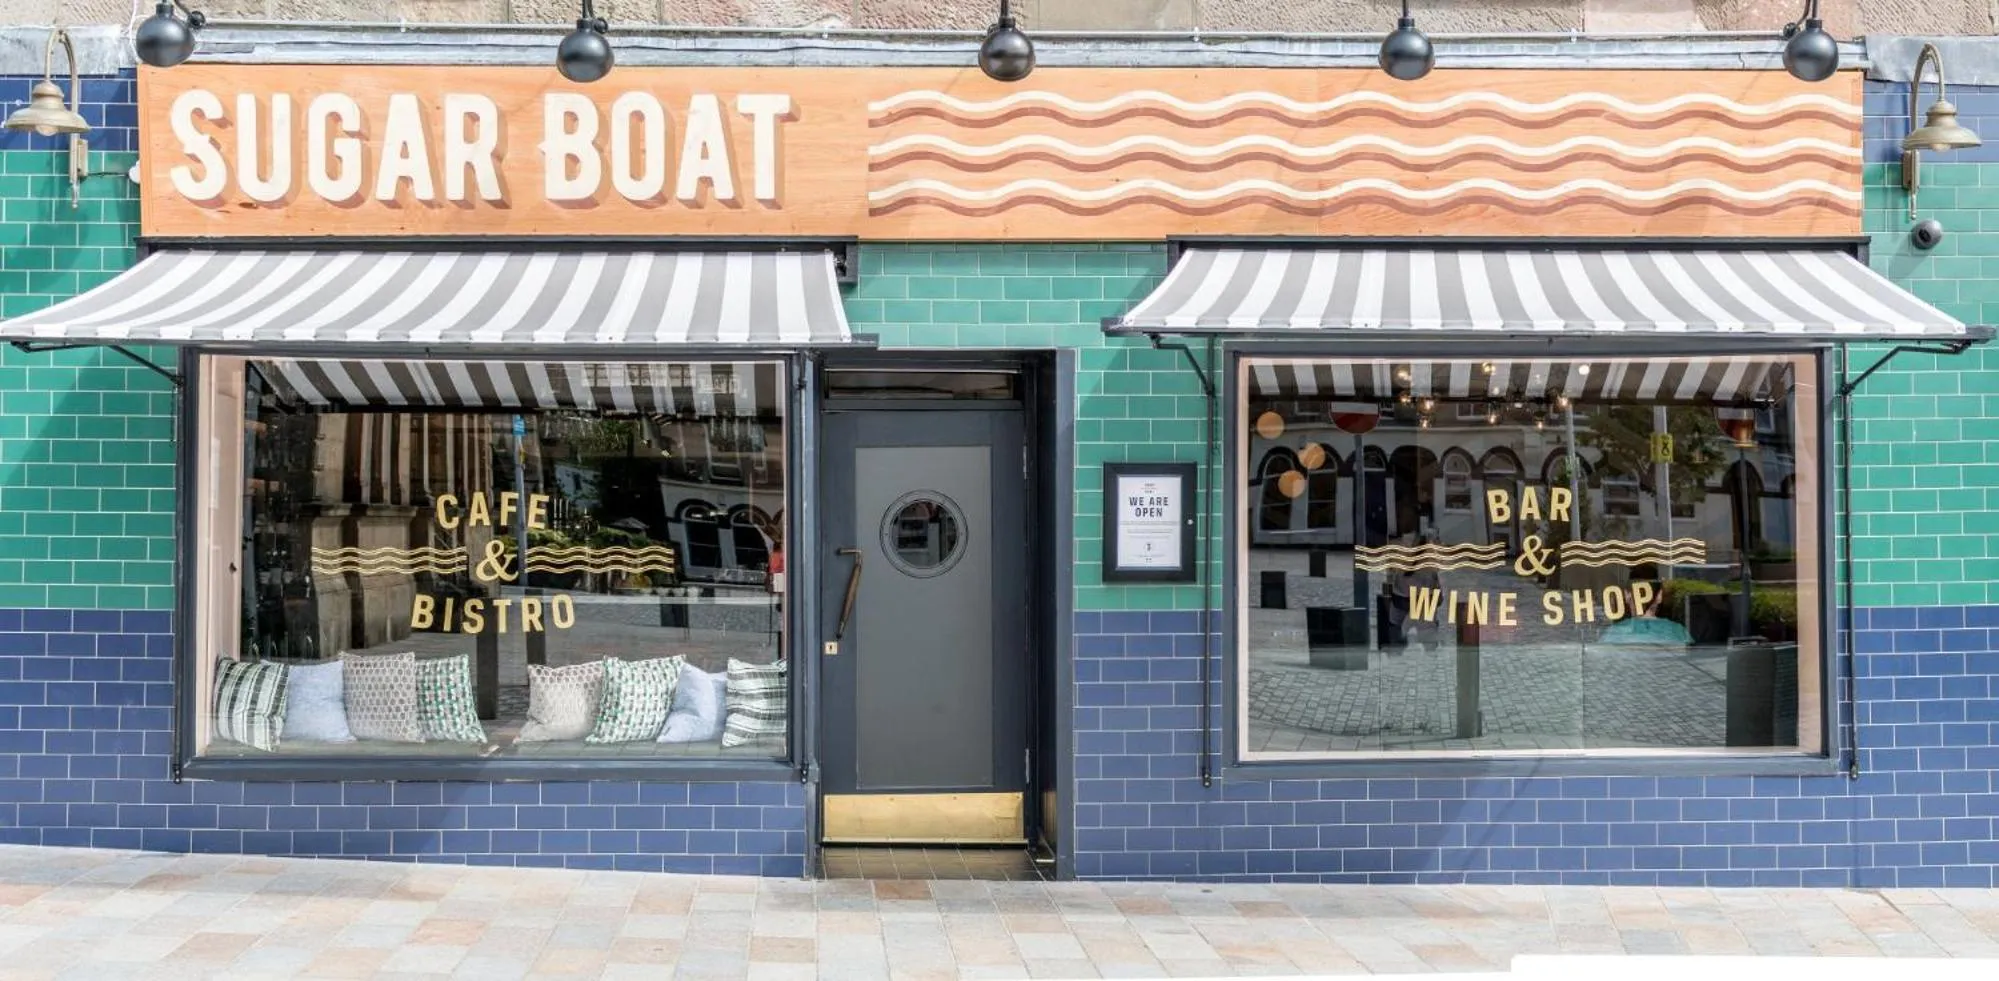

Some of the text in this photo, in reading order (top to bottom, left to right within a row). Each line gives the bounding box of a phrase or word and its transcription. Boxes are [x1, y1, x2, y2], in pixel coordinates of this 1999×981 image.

[169, 89, 792, 203] SUGAR BOAT
[436, 492, 550, 529] CAFE
[1129, 496, 1169, 506] WE ARE
[1135, 507, 1163, 517] OPEN
[1486, 486, 1572, 524] BAR
[476, 540, 519, 582] &
[1513, 534, 1556, 577] &
[411, 594, 575, 634] BISTRO
[1409, 580, 1654, 626] WINE SHOP
